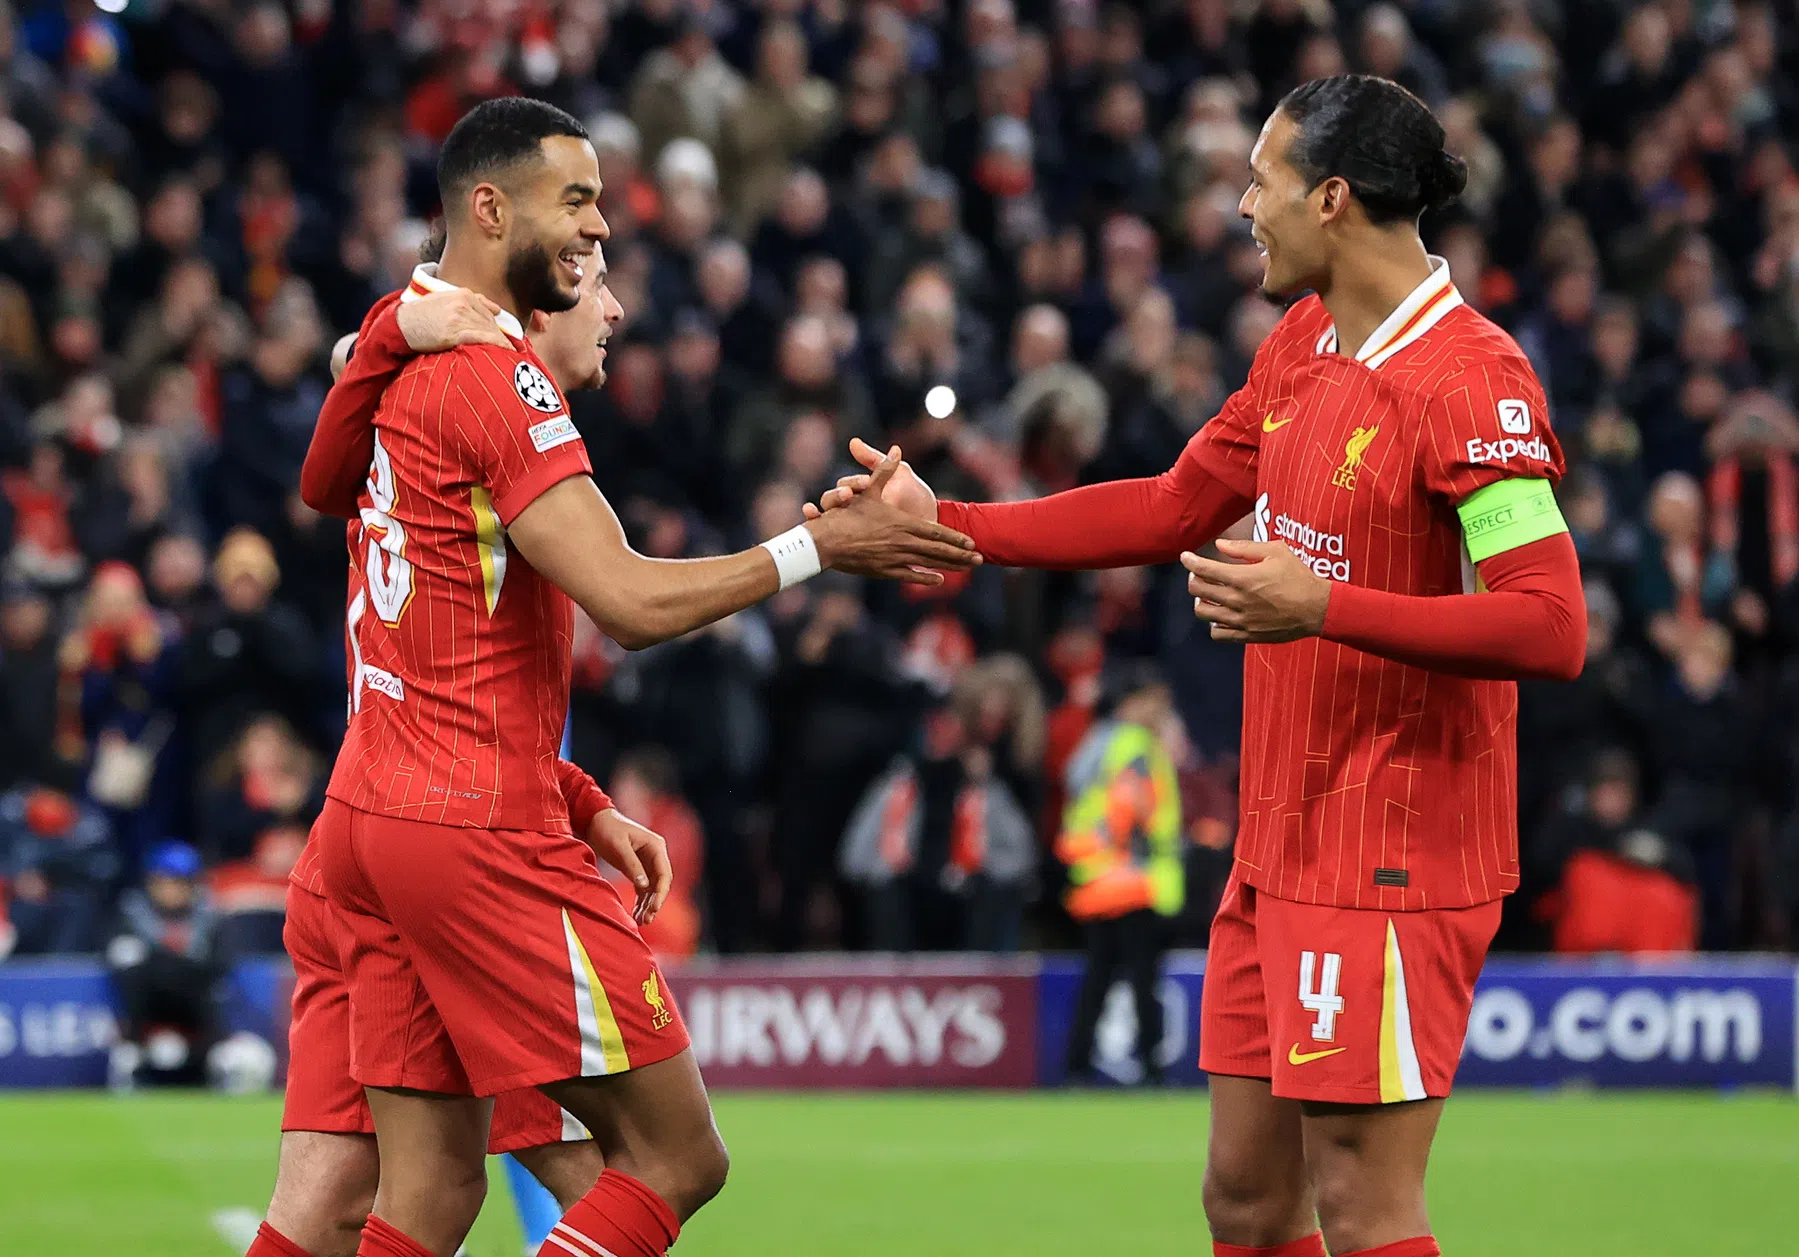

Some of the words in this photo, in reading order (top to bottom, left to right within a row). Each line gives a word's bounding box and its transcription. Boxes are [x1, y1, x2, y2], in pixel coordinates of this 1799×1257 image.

[1274, 512, 1343, 556] standard
[1298, 950, 1345, 1043] 4
[1469, 986, 1763, 1064] o.com
